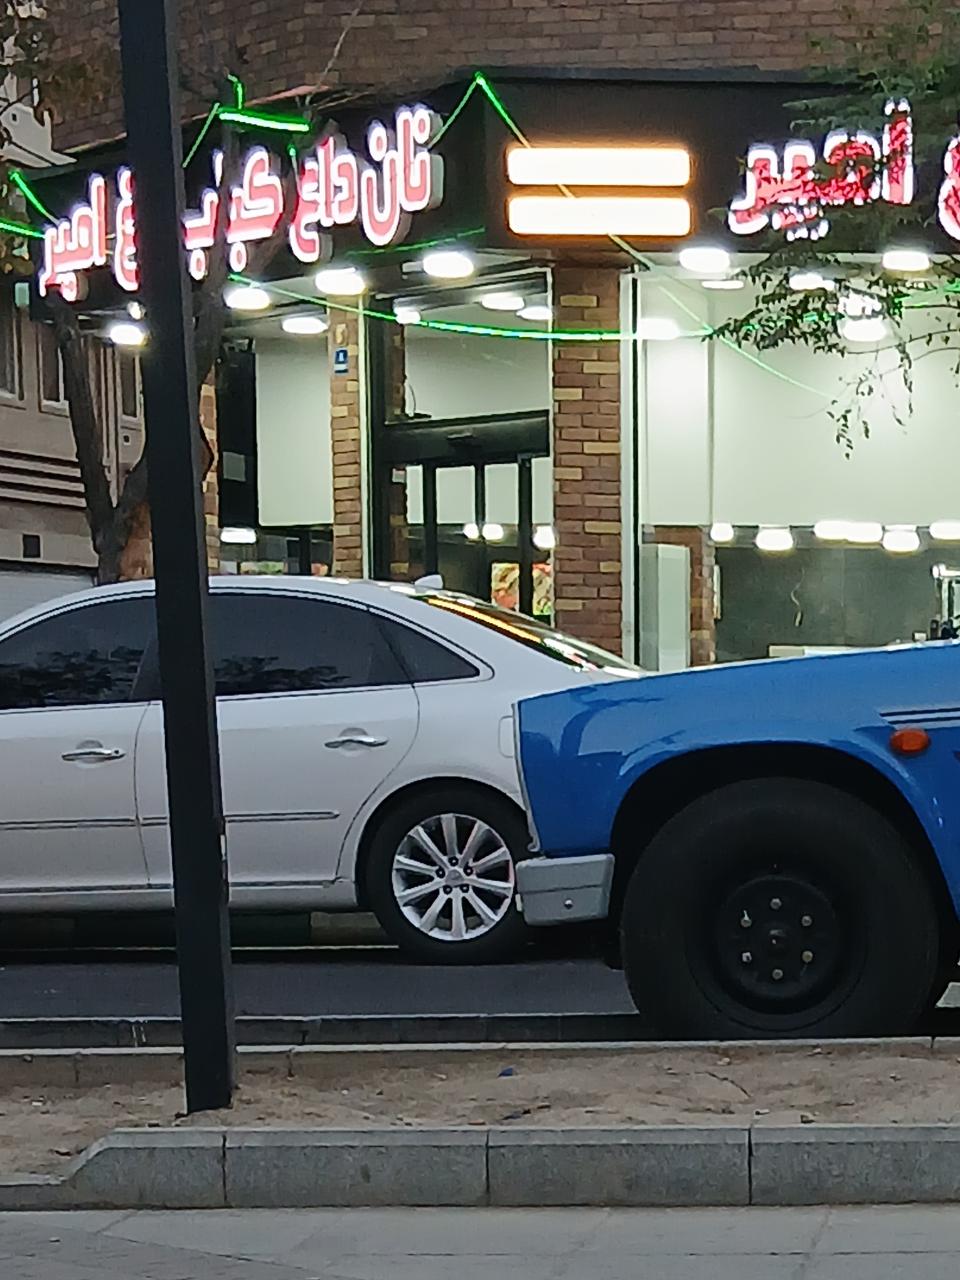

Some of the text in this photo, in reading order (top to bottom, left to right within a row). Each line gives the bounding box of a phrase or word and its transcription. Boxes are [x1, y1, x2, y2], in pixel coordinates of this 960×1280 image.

[181, 147, 284, 281] کبب
[362, 105, 431, 247] نان
[728, 98, 914, 241] امیر
